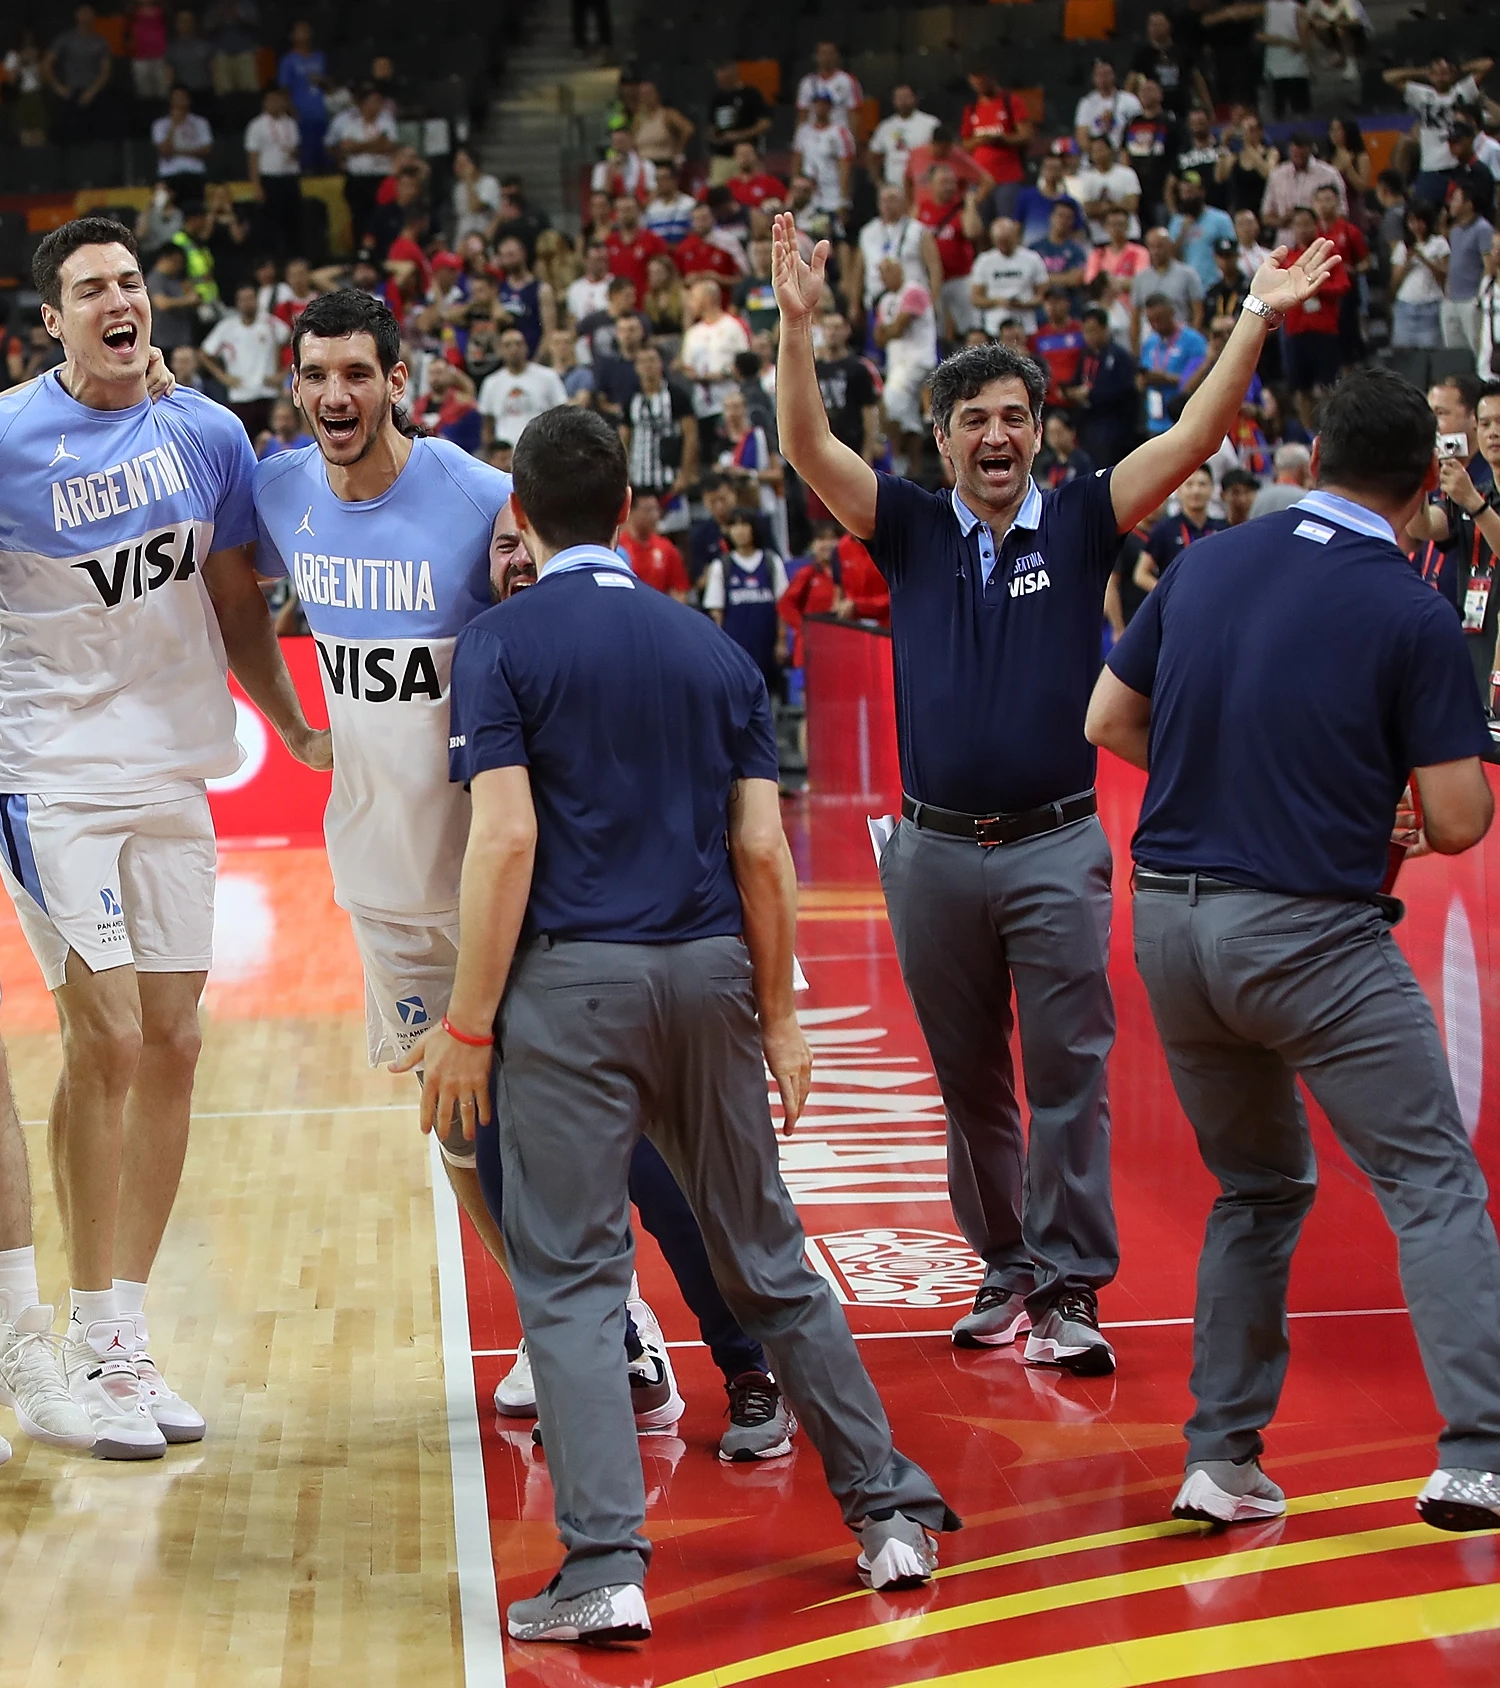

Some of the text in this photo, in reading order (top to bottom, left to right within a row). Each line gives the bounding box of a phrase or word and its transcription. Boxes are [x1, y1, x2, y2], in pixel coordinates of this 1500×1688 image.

[294, 552, 436, 611] ARGENTINA
[1008, 570, 1051, 598] VISA
[315, 639, 442, 702] VISA
